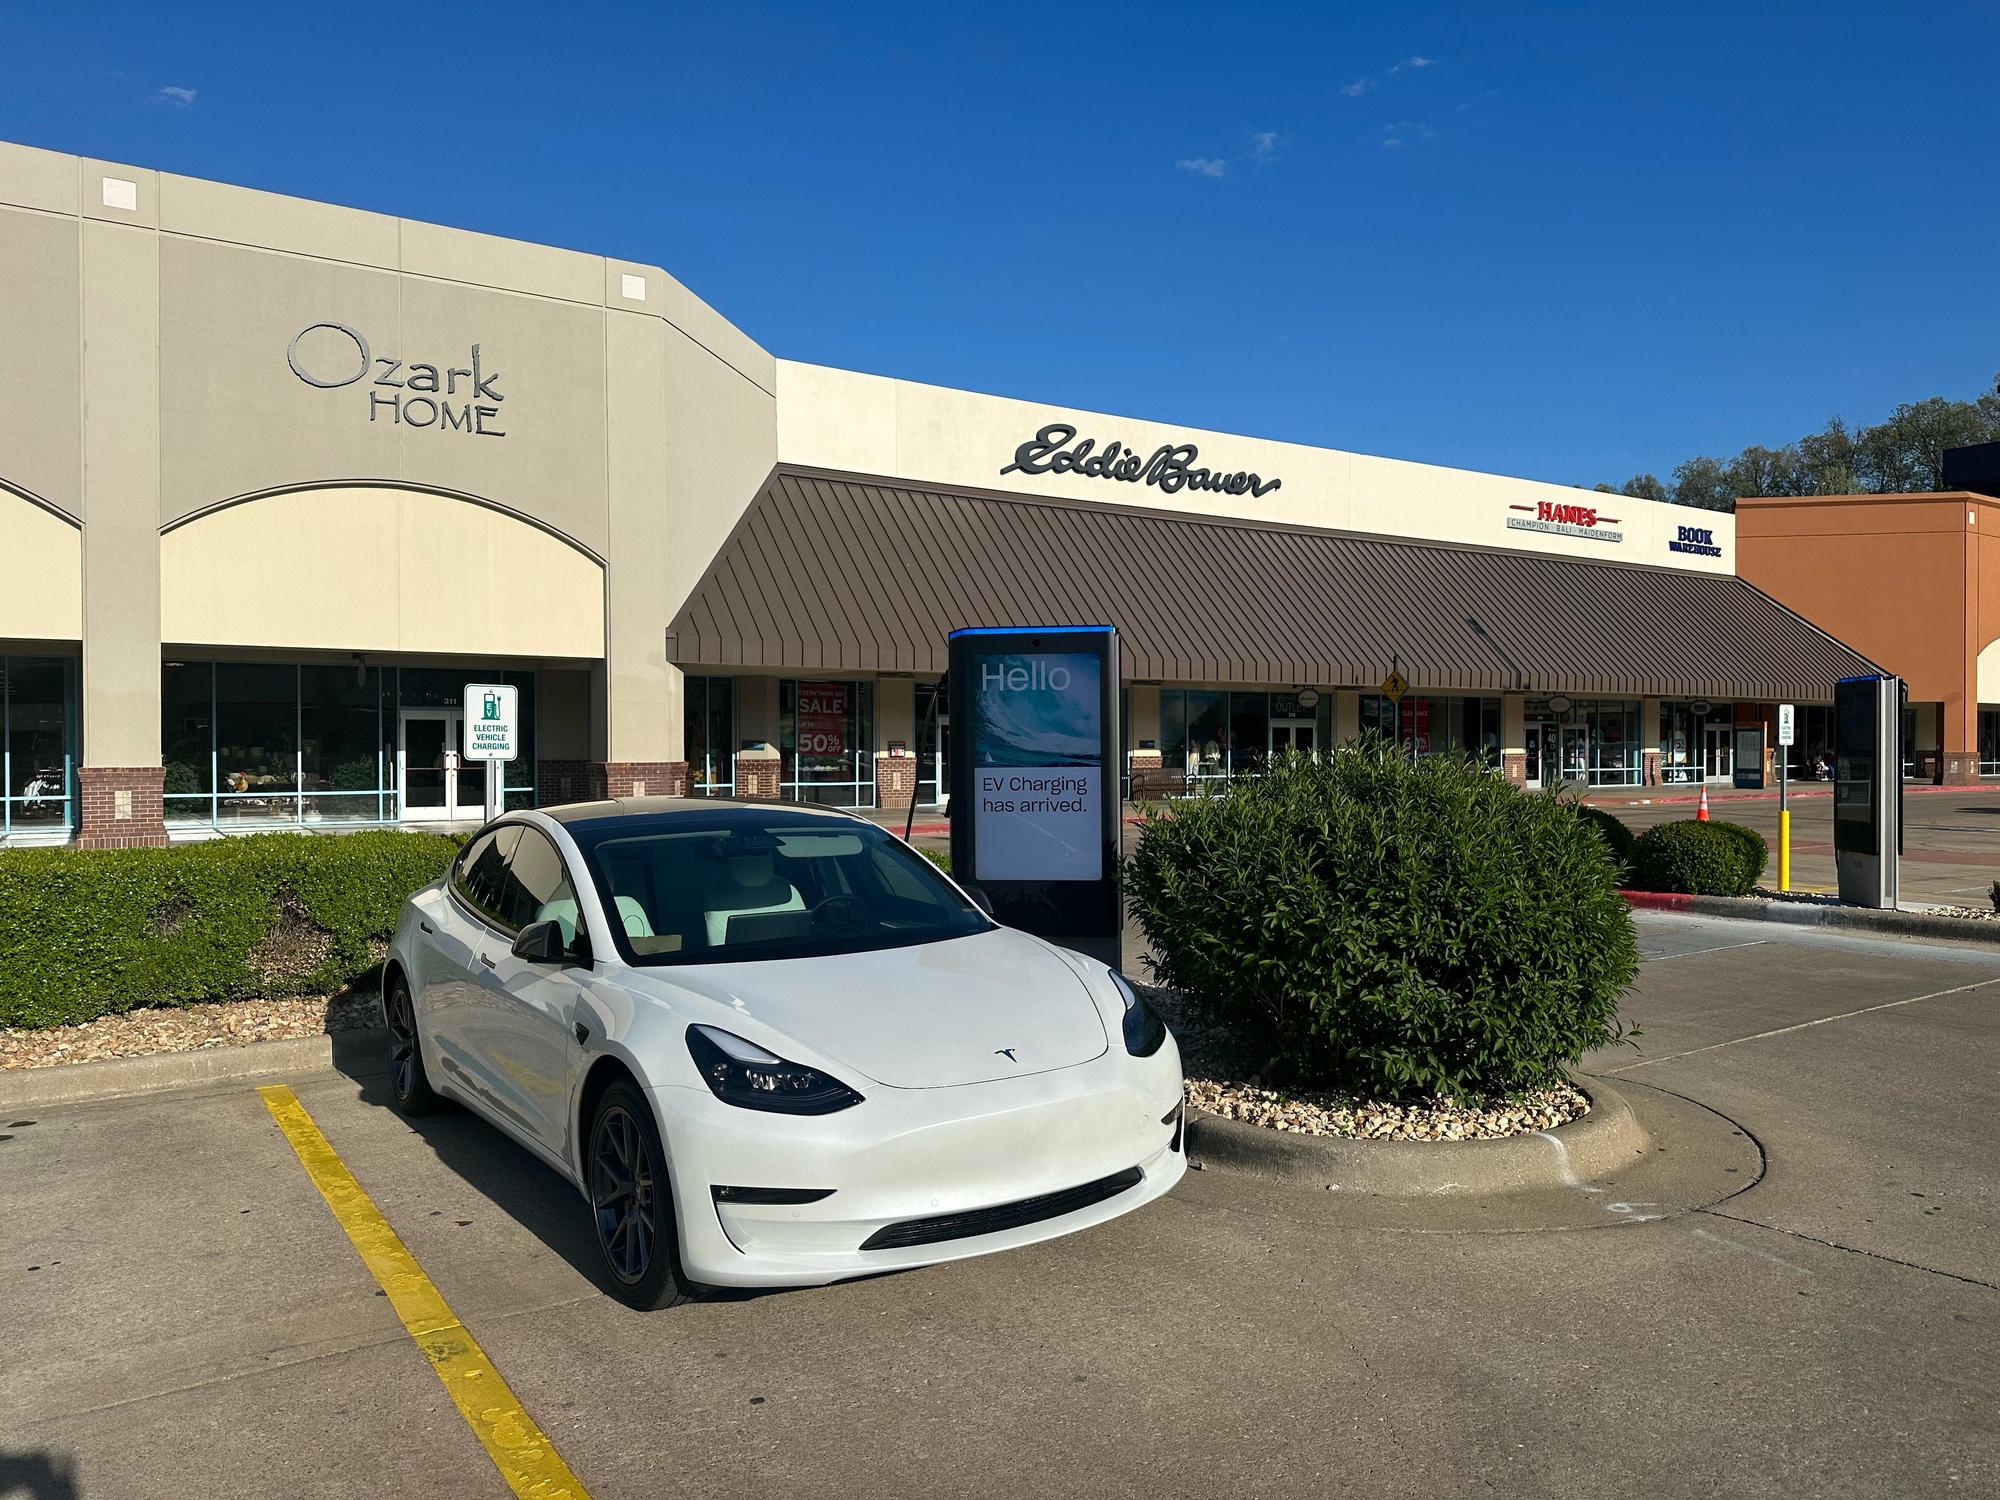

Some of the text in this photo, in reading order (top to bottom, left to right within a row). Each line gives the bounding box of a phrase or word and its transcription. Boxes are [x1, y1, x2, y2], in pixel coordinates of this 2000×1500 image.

[287, 321, 504, 402] Ozark
[370, 391, 506, 437] HOME
[1000, 423, 1282, 498] Eddie Bauer
[1537, 501, 1597, 527] HANES
[1511, 518, 1623, 541] CHAMPION BALI MAIDENFORM
[1677, 526, 1713, 545] BOOK
[1669, 541, 1722, 557] WAREHOUSE
[982, 661, 1071, 691] Hello
[799, 698, 843, 714] SALE
[473, 724, 508, 732] ELECTRIC
[476, 733, 506, 741] VEHICLE
[472, 742, 510, 750] CHARGING
[799, 733, 840, 752] 50%
[983, 776, 1088, 795] EV Charging
[983, 797, 1087, 813] has arrived.
